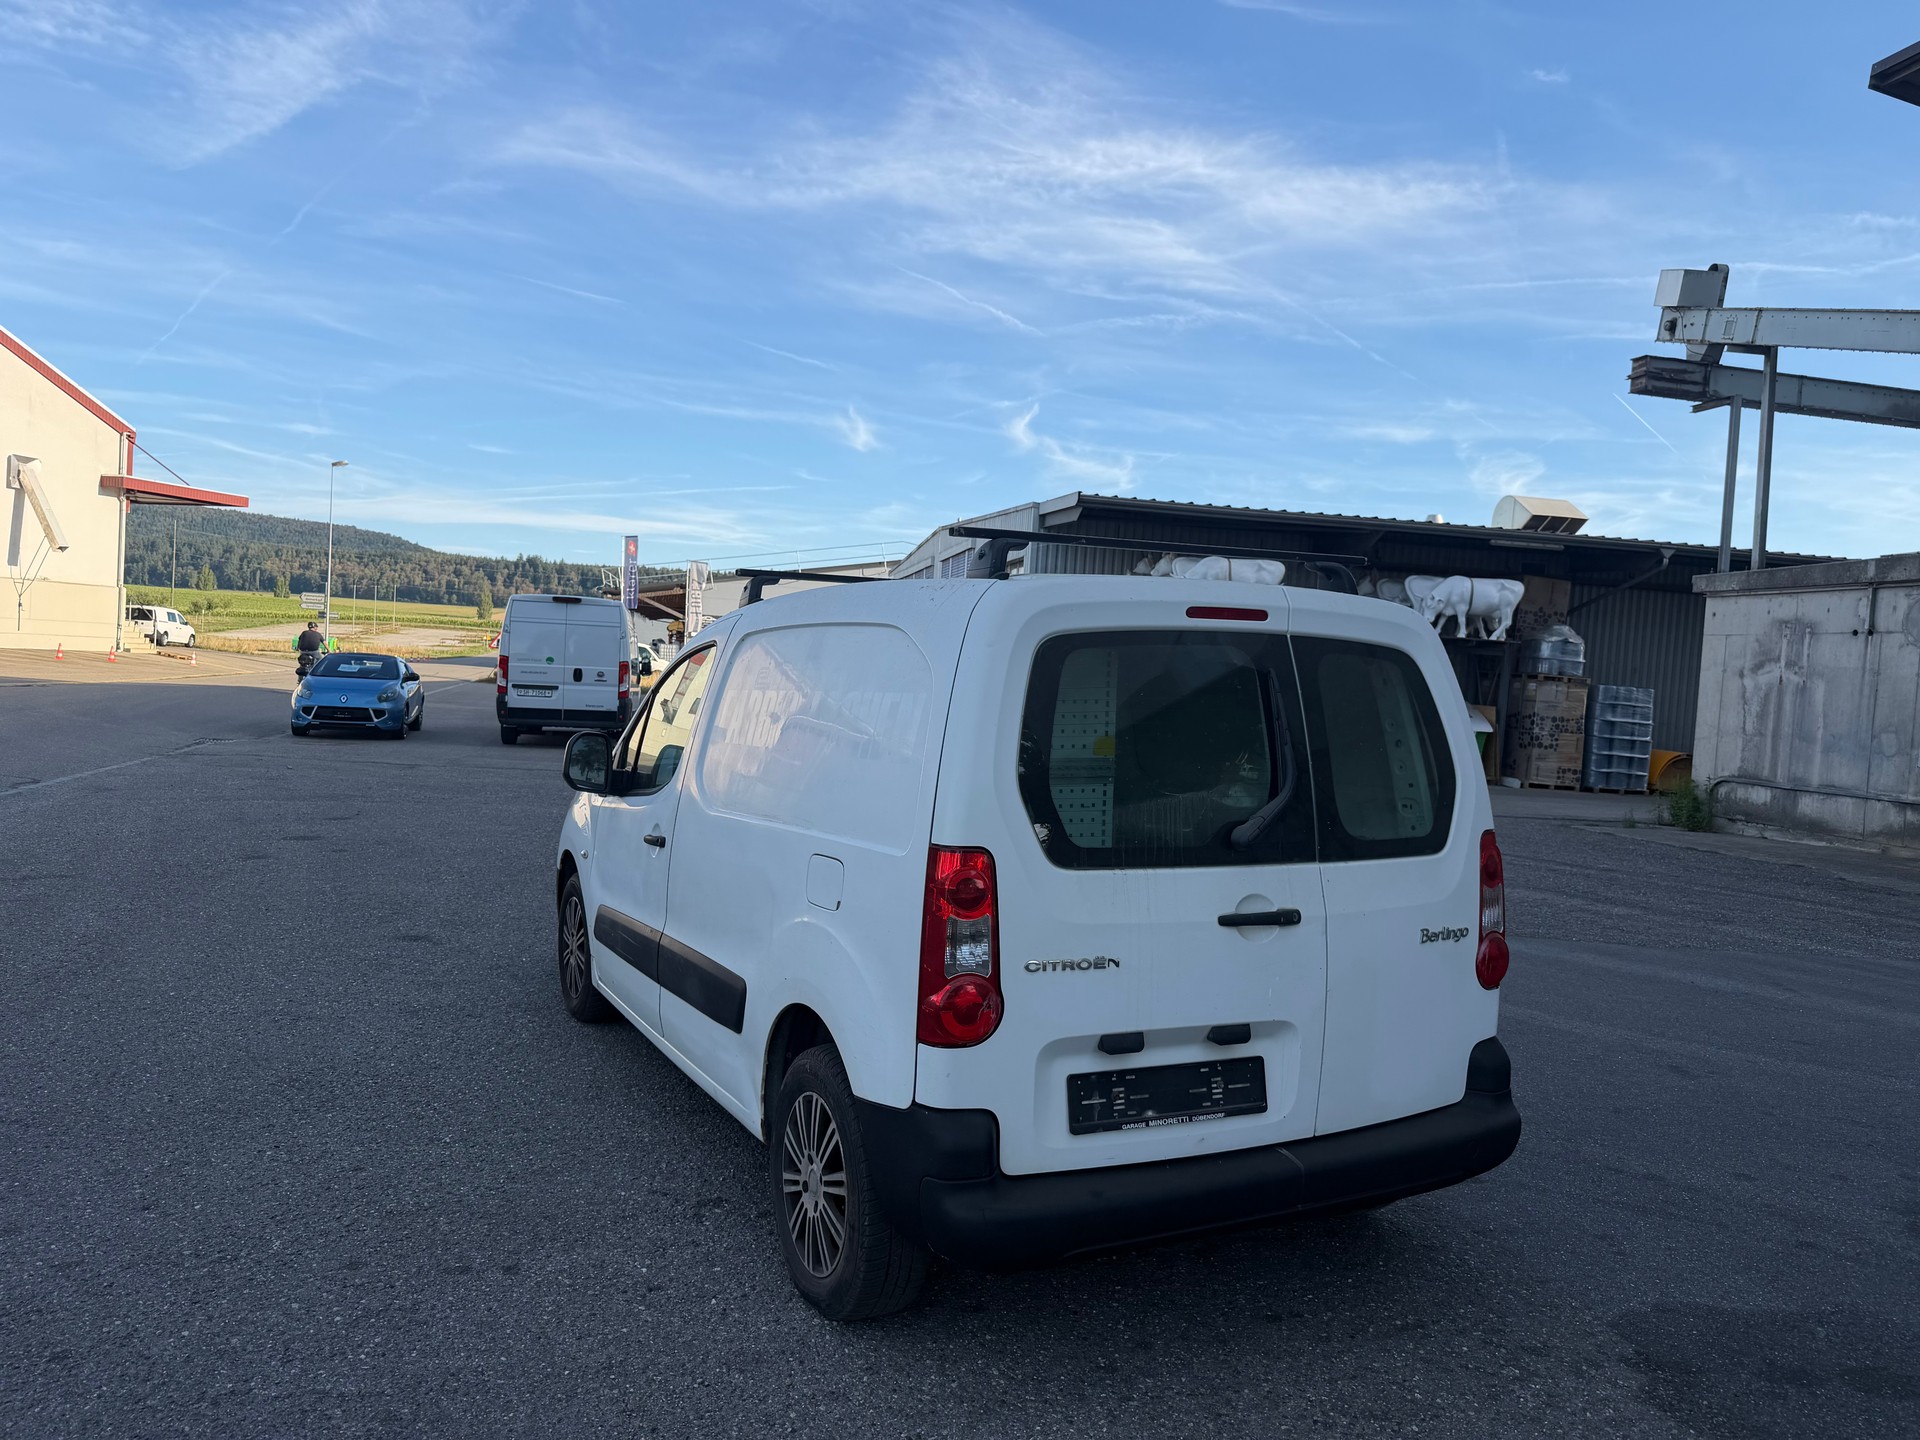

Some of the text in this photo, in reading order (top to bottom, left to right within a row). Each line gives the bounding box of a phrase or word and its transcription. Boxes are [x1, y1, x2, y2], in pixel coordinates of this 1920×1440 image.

[1420, 926, 1469, 944] Berlingo
[1023, 955, 1120, 973] CITROËN
[1121, 1112, 1226, 1130] GARAGE MINORETTI DÜBENDORF
